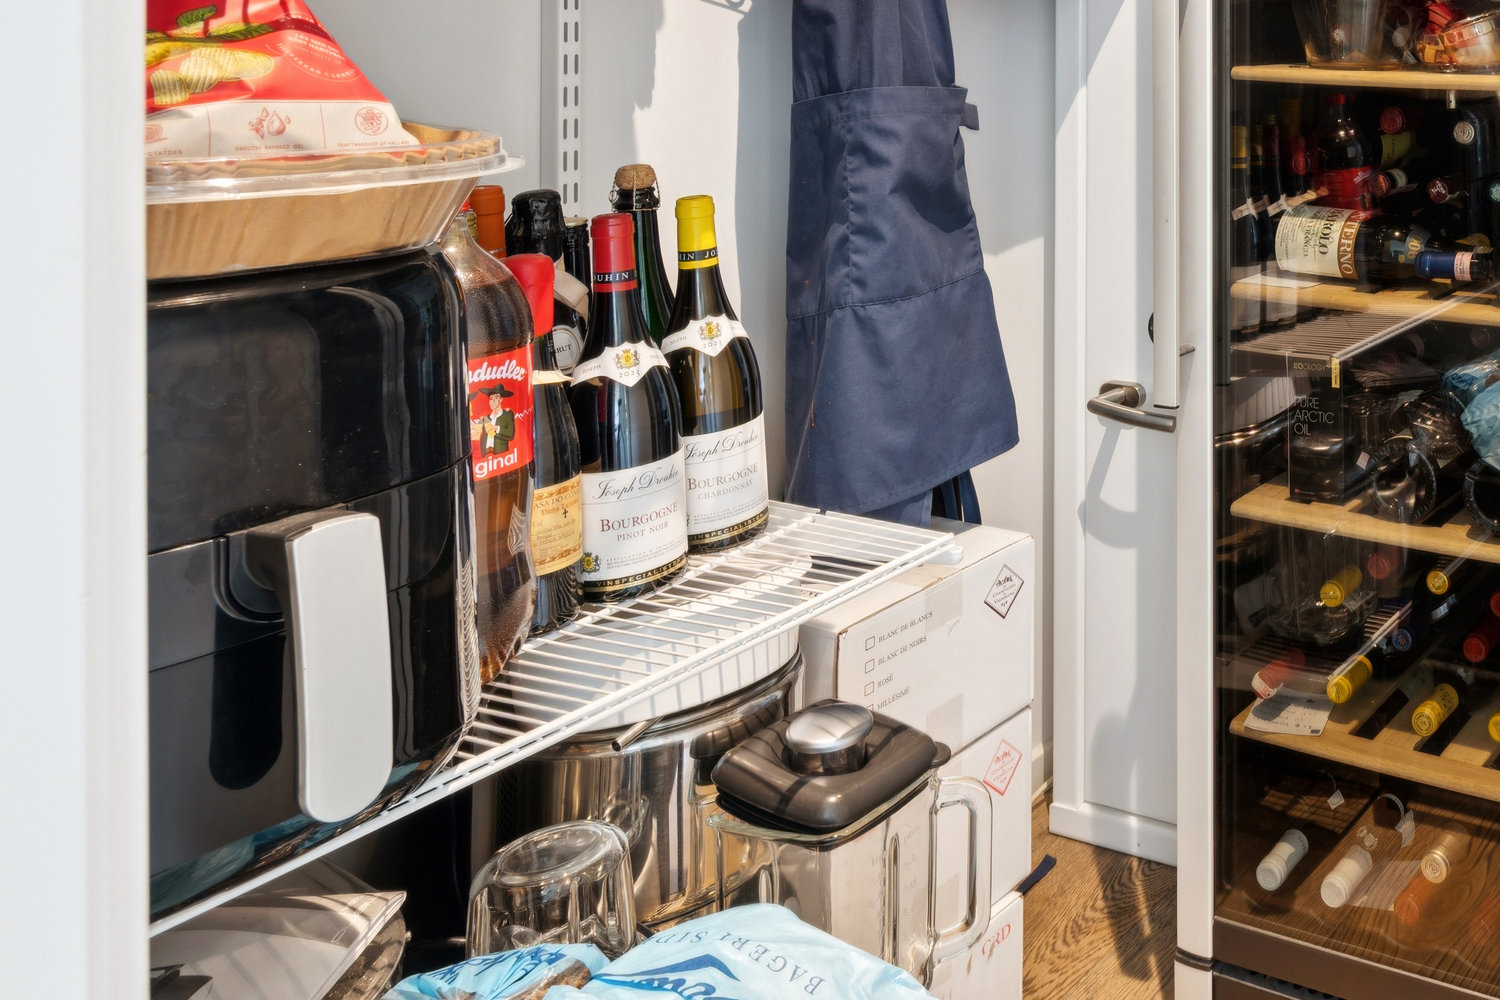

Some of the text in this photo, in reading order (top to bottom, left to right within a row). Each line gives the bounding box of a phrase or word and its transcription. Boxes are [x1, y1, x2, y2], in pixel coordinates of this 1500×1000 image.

[1340, 210, 1363, 275] NTERNO
[592, 272, 630, 282] OUHIN
[468, 360, 526, 382] dudler
[582, 364, 602, 375] JOSEPH
[619, 370, 641, 379] 2023
[1294, 397, 1319, 409] PURE
[1294, 410, 1334, 424] ARCTIC
[1294, 422, 1311, 436] OIL
[685, 440, 720, 461] Joseph
[475, 448, 518, 478] ginal
[687, 463, 759, 491] BOURGOGNE
[592, 476, 637, 500] Joseph
[698, 479, 753, 500] CHARDONNAY
[534, 499, 551, 509] ASA
[600, 501, 679, 533] BOURGOGNE
[617, 520, 671, 542] PINOT NOIR
[878, 611, 933, 643] BLANC DE BLANCS
[878, 635, 927, 666] BLANC DE NOIRS
[656, 929, 709, 945] SID
[719, 930, 826, 996] BAGERI
